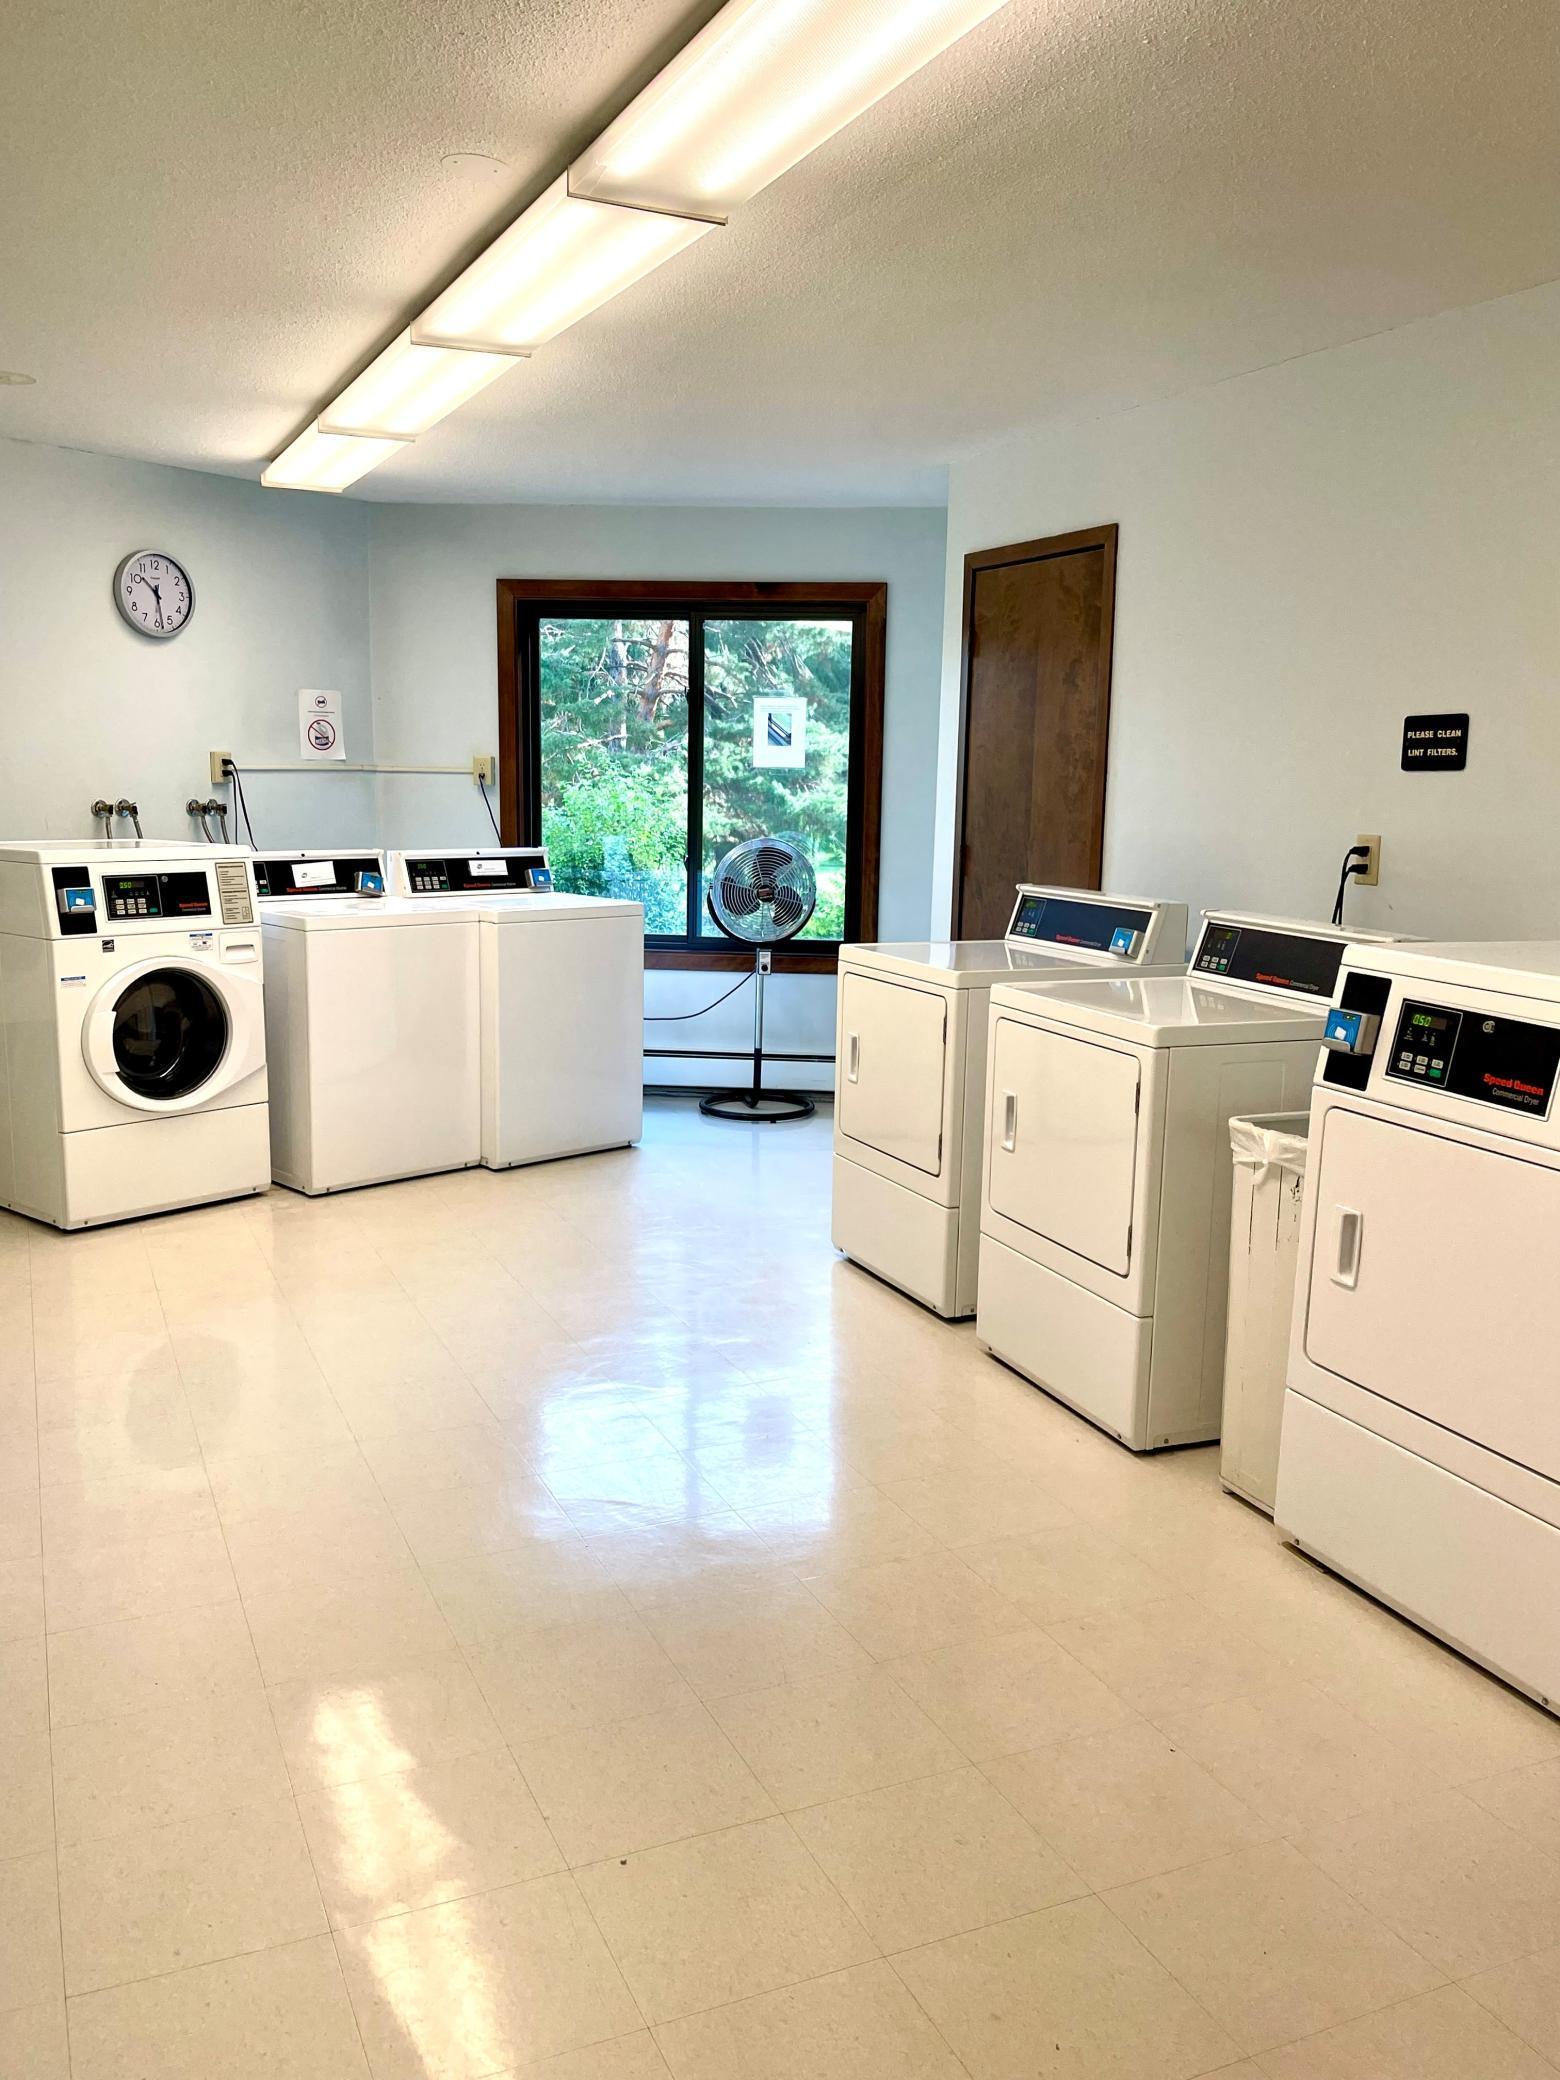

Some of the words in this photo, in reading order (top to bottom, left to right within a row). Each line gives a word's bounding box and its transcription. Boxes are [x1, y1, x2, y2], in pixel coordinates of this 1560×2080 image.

[139, 563, 146, 573] 11
[150, 560, 160, 571] 12
[130, 573, 142, 584] 10
[173, 576, 180, 586] 2
[126, 586, 133, 596] 9
[179, 592, 185, 602] 3
[131, 601, 138, 612] 8
[175, 605, 182, 615] 4
[142, 612, 148, 622] 7
[166, 616, 173, 625] 5
[154, 618, 160, 628] 6
[1407, 731, 1434, 739] PLEASE
[1437, 730, 1462, 738] CLEAN
[1408, 749, 1424, 757] LINT
[1427, 748, 1458, 756] FILTERS.
[1483, 1073, 1513, 1088] Speed
[1513, 1080, 1544, 1096] Queen
[1492, 1087, 1523, 1102] Commercial
[1523, 1095, 1540, 1106] Dryer
